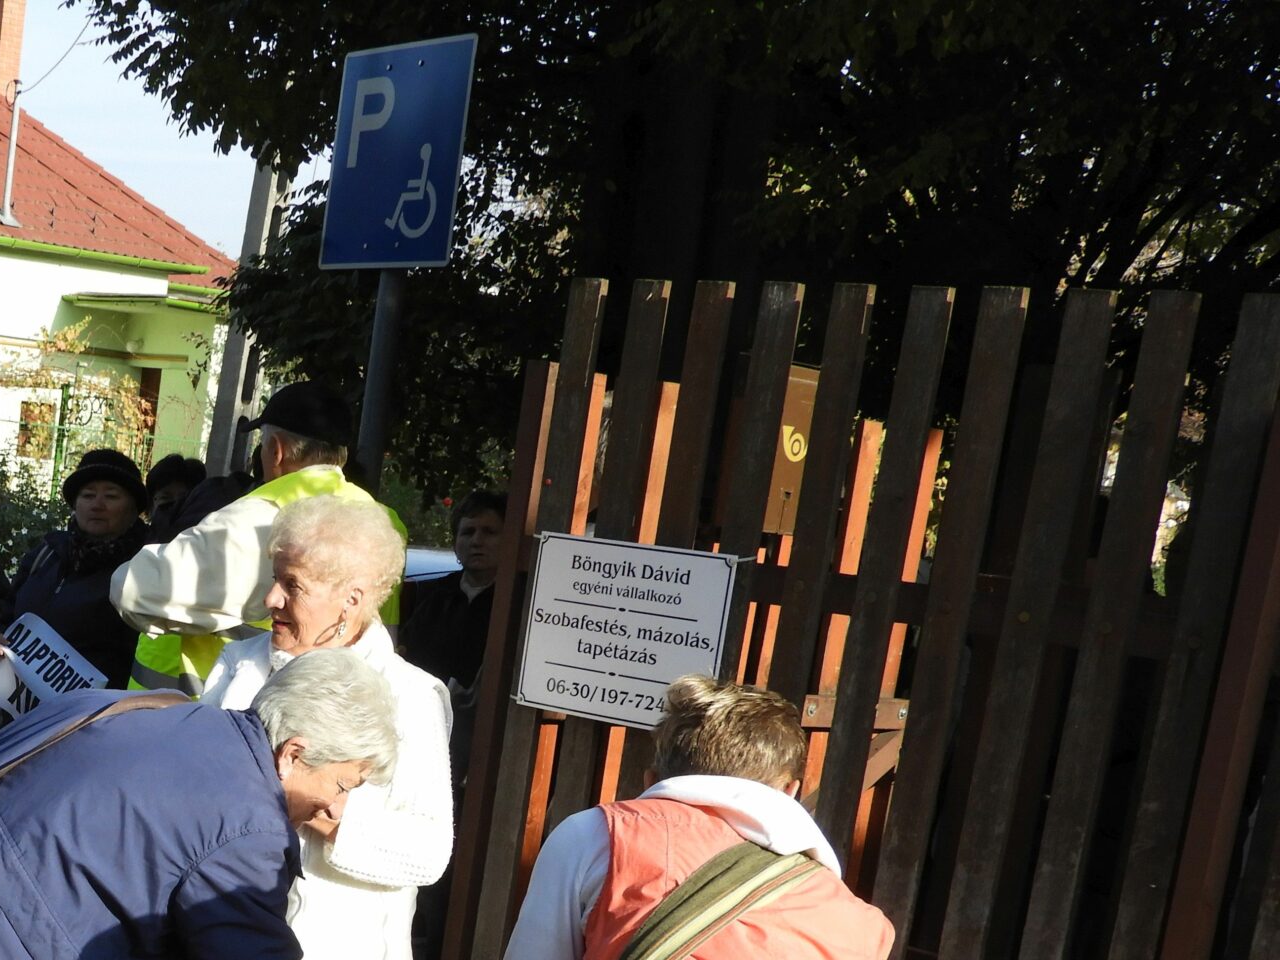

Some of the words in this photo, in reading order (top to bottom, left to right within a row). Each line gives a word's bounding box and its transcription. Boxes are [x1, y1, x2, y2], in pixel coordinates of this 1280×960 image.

[346, 76, 396, 168] P
[571, 555, 637, 579] Böngyik
[641, 564, 692, 585] Dávid
[573, 580, 614, 596] egyéni
[616, 585, 682, 606] vállalkozó
[534, 608, 632, 640] Szobafestés,
[637, 626, 715, 652] mázolás,
[577, 638, 657, 665] tapétázás
[546, 677, 665, 713] 06-30/197-724
